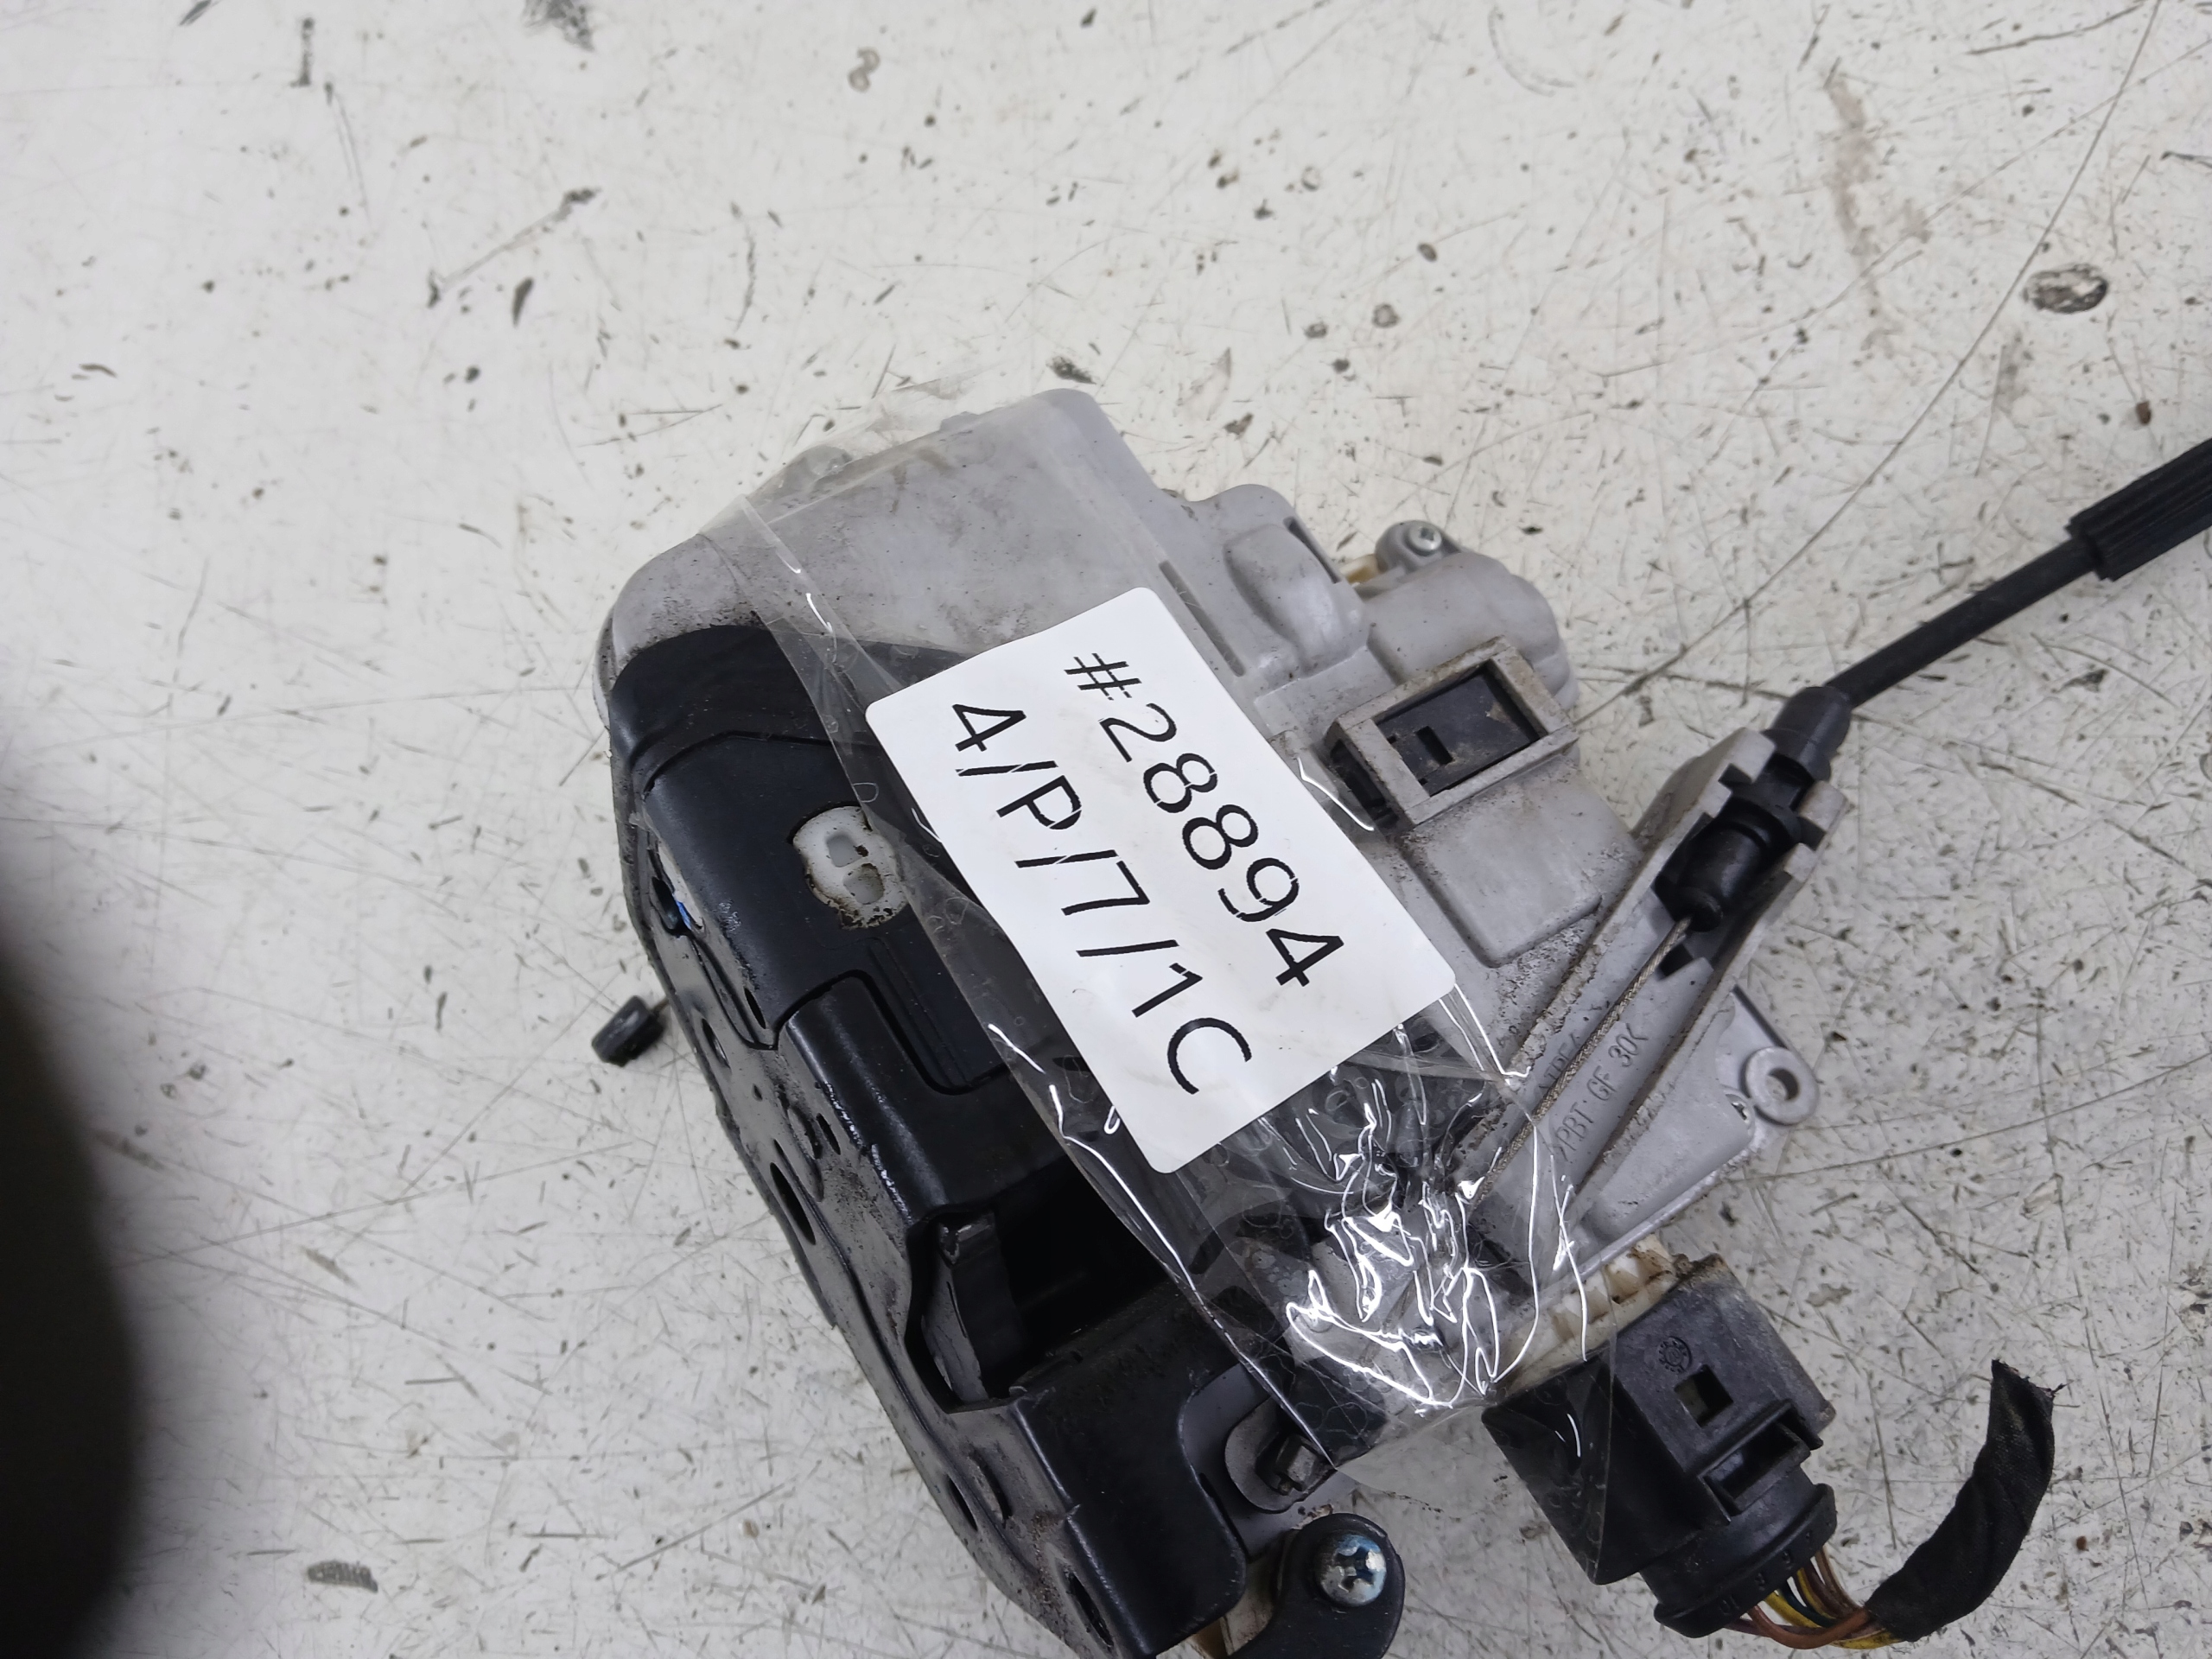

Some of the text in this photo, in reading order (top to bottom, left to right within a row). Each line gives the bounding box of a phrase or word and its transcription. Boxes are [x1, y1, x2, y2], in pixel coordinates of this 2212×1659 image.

[952, 703, 1252, 1095] 4/P/7/1C
[1064, 652, 1344, 987] #28894
[1586, 1065, 1618, 1103] GF
